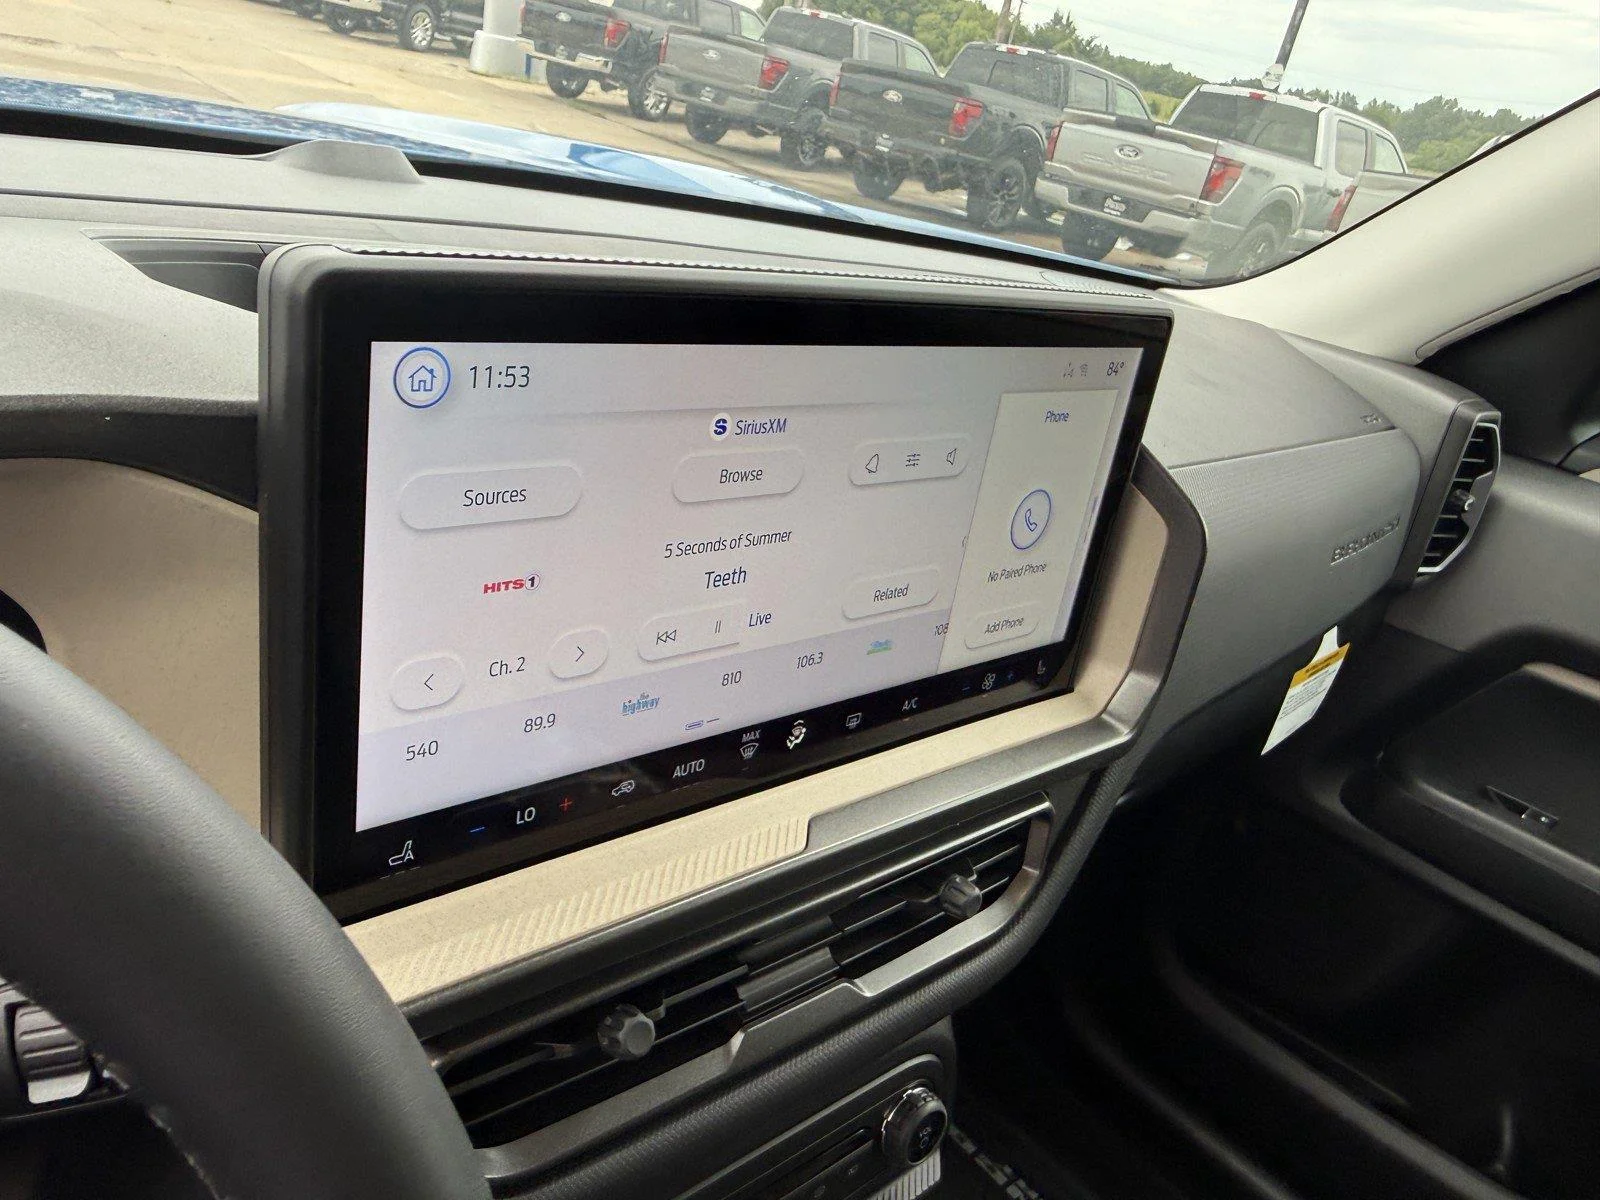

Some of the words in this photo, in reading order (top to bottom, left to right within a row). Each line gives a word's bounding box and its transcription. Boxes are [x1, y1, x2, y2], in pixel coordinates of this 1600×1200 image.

[468, 365, 531, 389] 11:53
[1044, 410, 1070, 423] Phone
[734, 417, 788, 436] SiriusXM
[718, 467, 764, 485] Browse
[462, 487, 528, 508] Sources
[663, 542, 673, 559] 5
[675, 538, 727, 557] Seconds
[729, 535, 744, 551] of
[744, 530, 792, 548] Summer
[704, 567, 748, 589] Teeth
[987, 571, 998, 583] No
[999, 566, 1024, 581] Paired
[1024, 562, 1048, 576] Phone
[873, 585, 909, 603] Related
[748, 611, 772, 628] Live
[984, 622, 1000, 635] Add
[1000, 616, 1025, 631] Phone
[489, 660, 514, 678] Ch.
[515, 656, 526, 672] 2
[795, 651, 824, 670] 106.3
[721, 670, 743, 687] 810
[621, 697, 660, 715] highway
[901, 696, 920, 711] A/C
[523, 712, 557, 733] 89.9
[741, 729, 761, 742] MAX
[405, 740, 439, 762] 540
[672, 758, 706, 778] AUTO
[515, 806, 536, 826] LO
